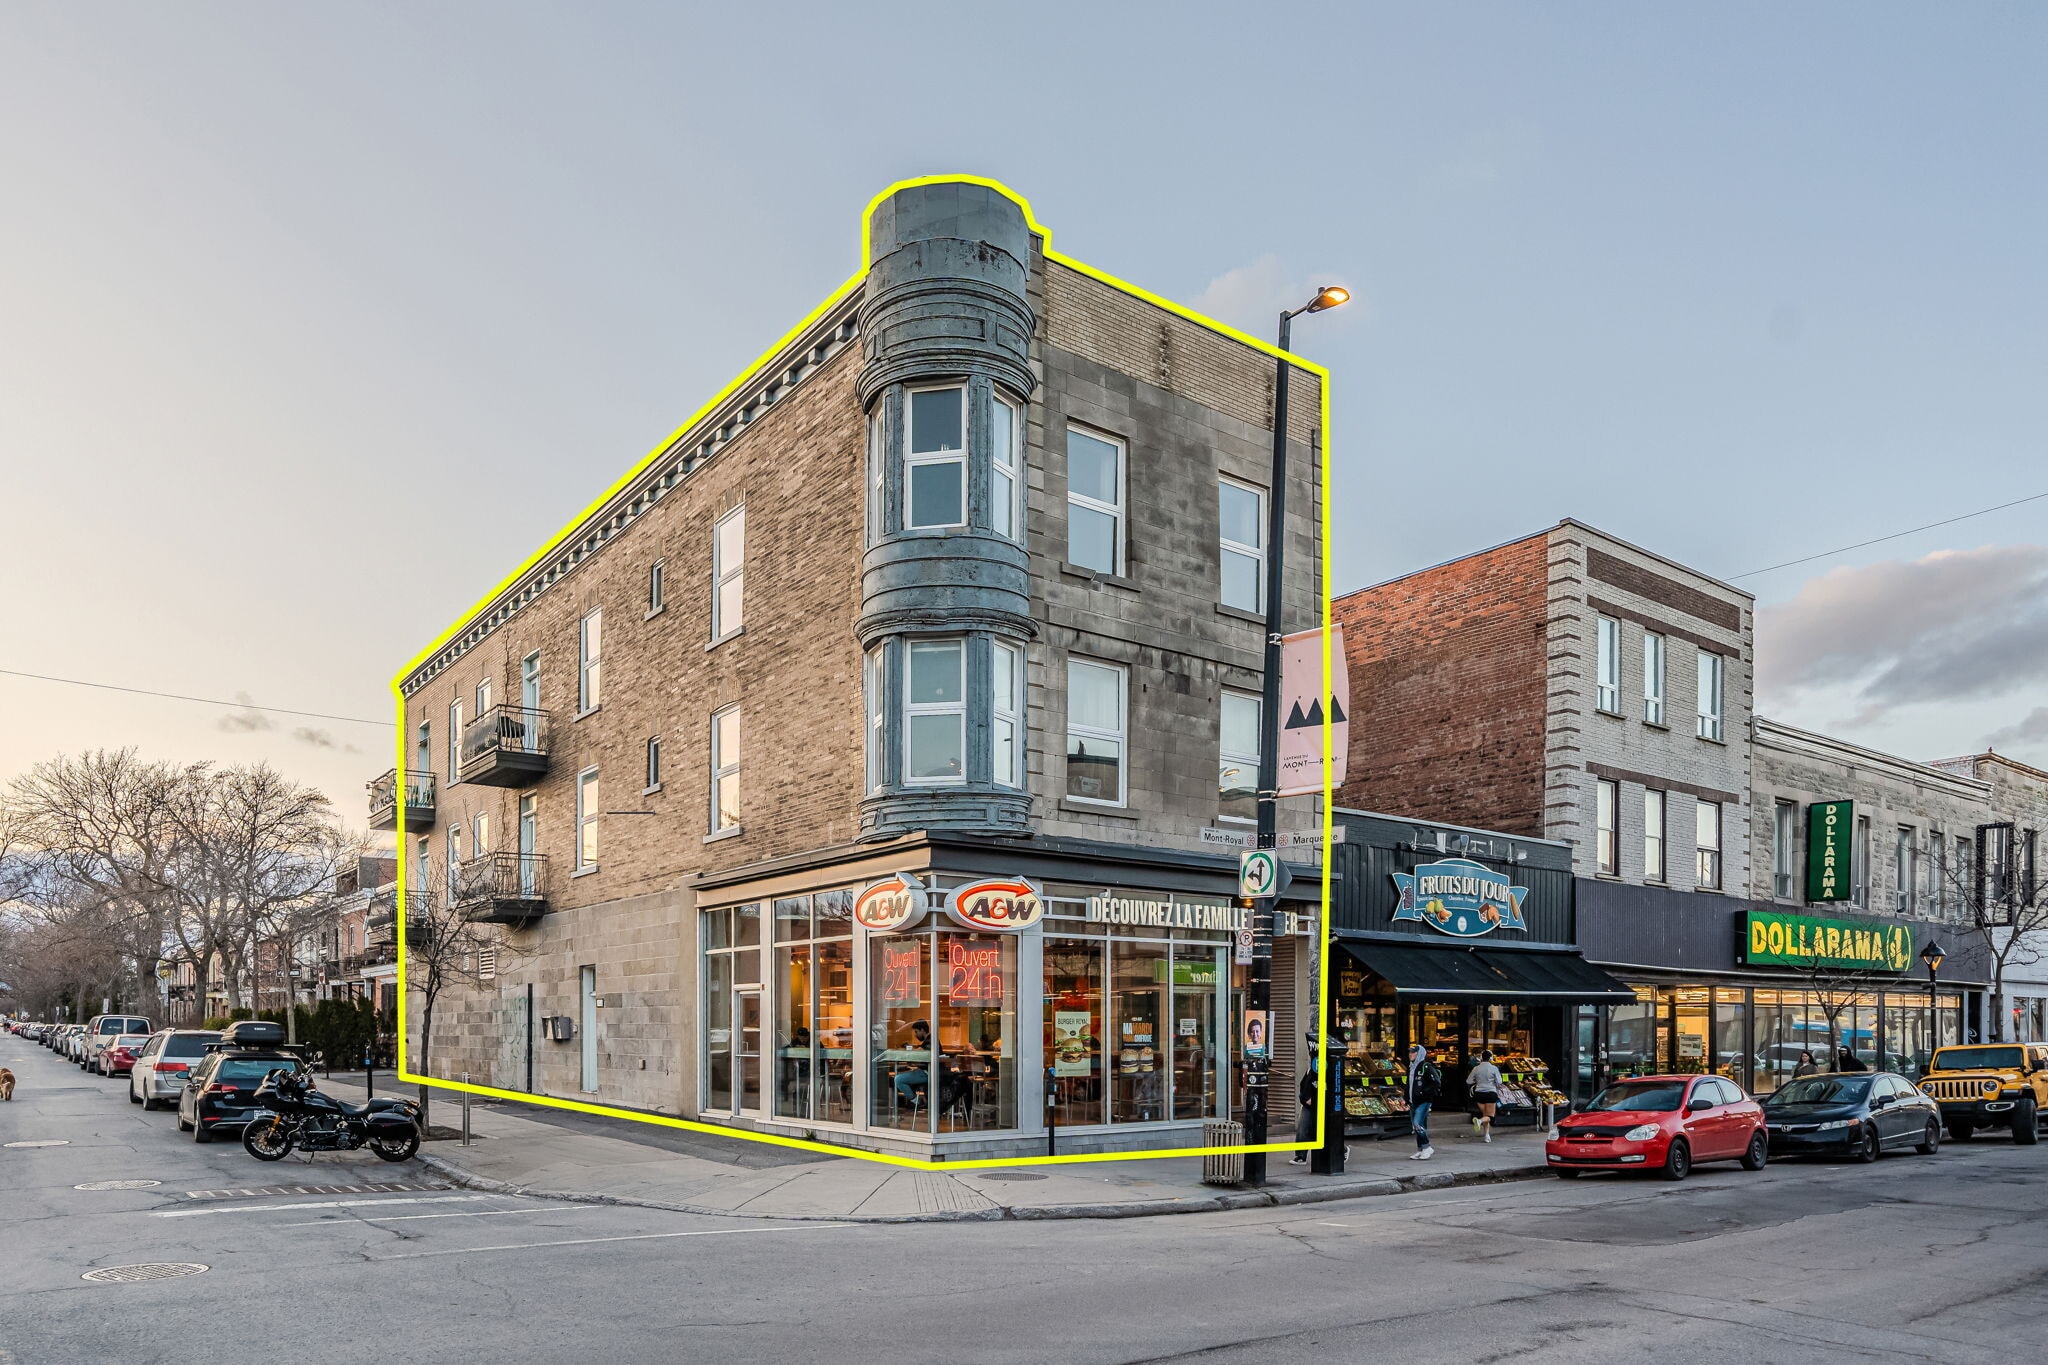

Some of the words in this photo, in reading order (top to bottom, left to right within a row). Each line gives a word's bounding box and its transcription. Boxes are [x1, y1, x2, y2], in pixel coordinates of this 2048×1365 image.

[1204, 832, 1244, 846] Mont-Royal
[1293, 834, 1338, 845] Marquee
[1822, 804, 1837, 898] DOLLARAMA
[1420, 875, 1461, 895] FRUITS
[1461, 876, 1480, 896] DU
[1480, 879, 1510, 903] JOUR
[863, 895, 910, 922] A&W
[966, 896, 1037, 921] A&W
[1091, 891, 1173, 926] DÉCOUVREZ
[1176, 903, 1193, 928] LA
[1195, 904, 1249, 930] FAMILLE
[1751, 920, 1885, 961] DOLLARAMA
[884, 947, 918, 967] Ouvert
[952, 944, 1000, 967] Ouvert
[884, 968, 920, 1000] 24H
[951, 967, 1002, 999] 24h
